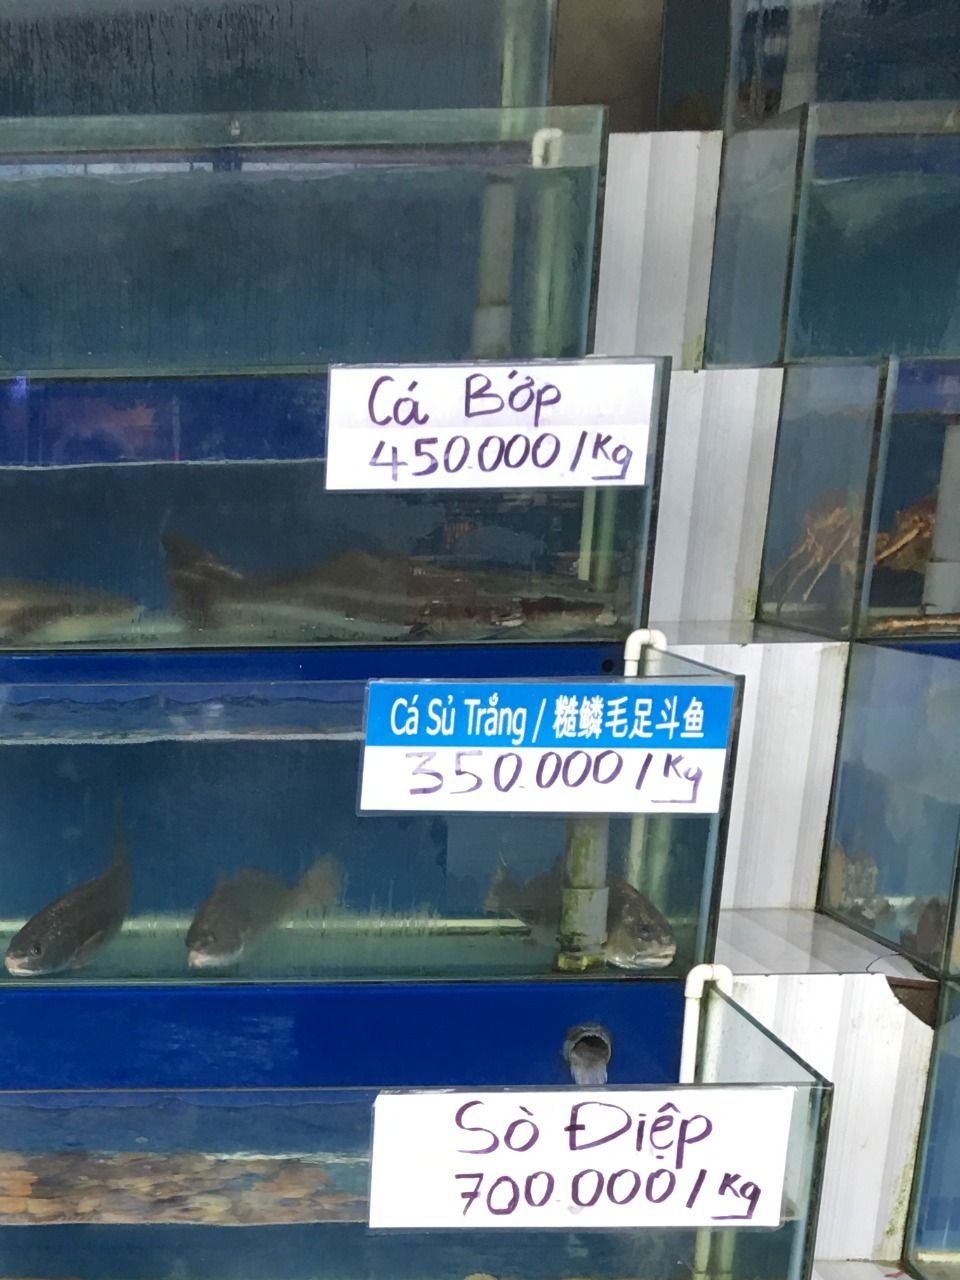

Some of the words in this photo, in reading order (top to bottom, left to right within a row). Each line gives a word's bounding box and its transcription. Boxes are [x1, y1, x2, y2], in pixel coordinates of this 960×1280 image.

[368, 376, 429, 425] Cá
[465, 370, 561, 427] Bớp
[390, 694, 419, 736] Cá
[426, 694, 456, 736] Sủ
[464, 692, 527, 746] Trắng
[455, 1100, 539, 1154] Sò
[564, 1102, 712, 1169] Điệp
